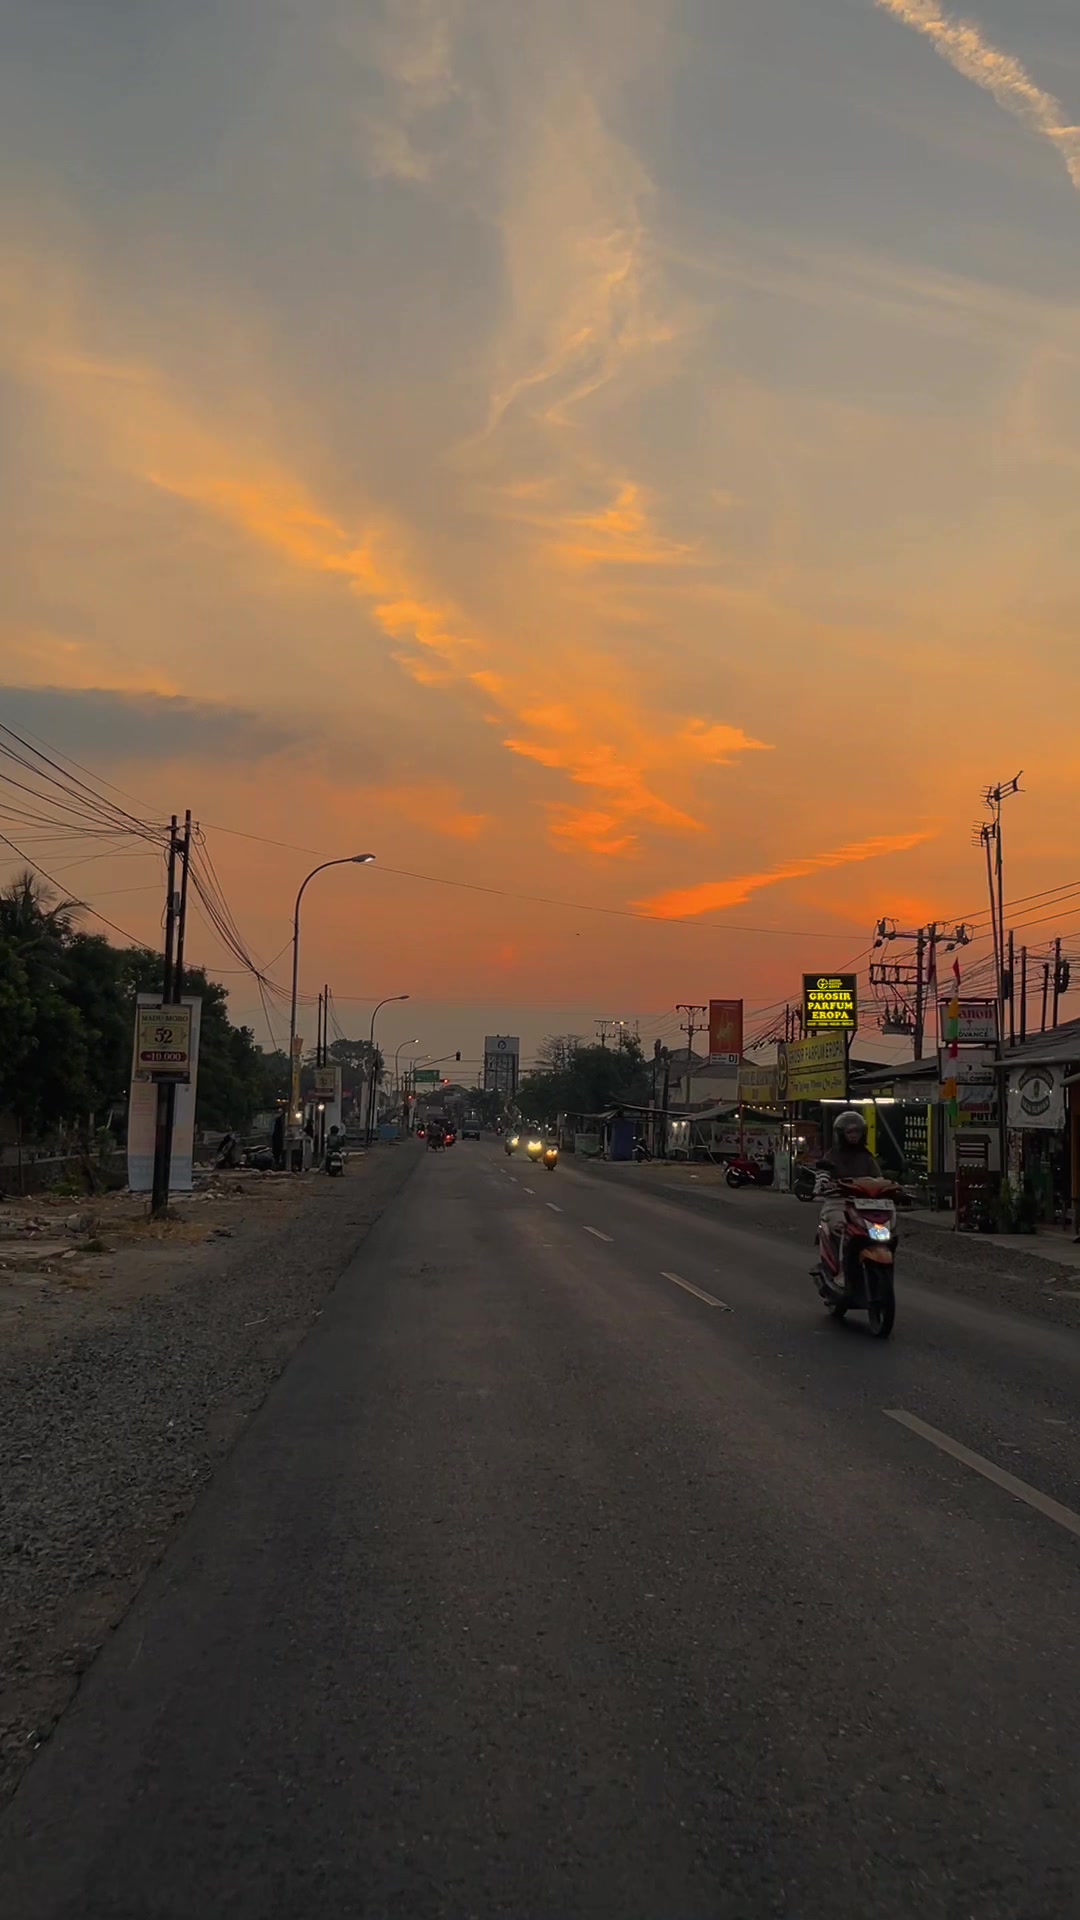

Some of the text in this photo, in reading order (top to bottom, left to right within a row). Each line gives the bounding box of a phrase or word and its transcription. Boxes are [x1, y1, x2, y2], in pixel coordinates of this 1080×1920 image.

[809, 992, 851, 1001] GROSIR
[807, 1002, 853, 1010] PARFUM
[812, 1011, 849, 1019] EROPA
[154, 1027, 173, 1044] 52
